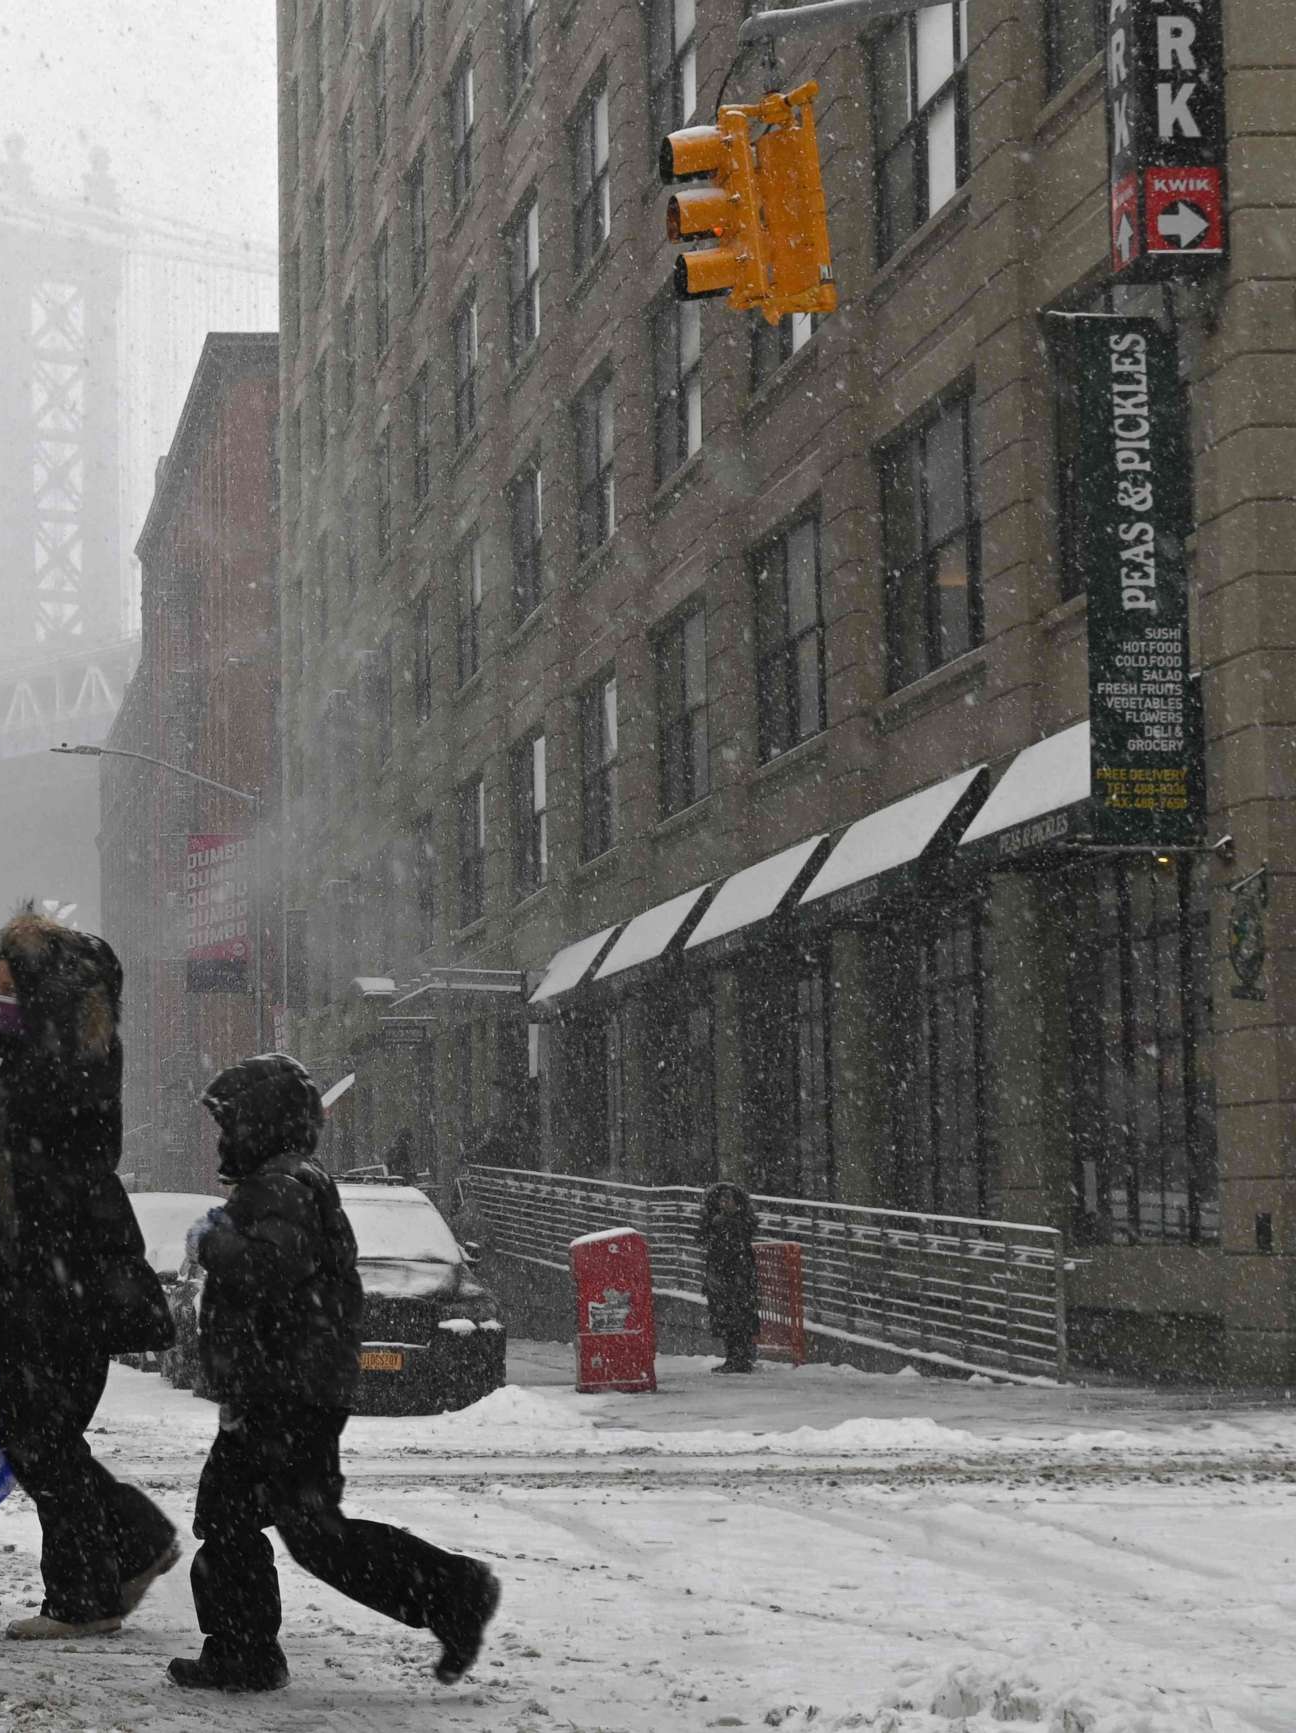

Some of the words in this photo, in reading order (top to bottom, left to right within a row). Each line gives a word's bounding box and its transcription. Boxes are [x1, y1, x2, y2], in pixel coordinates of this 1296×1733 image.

[1151, 0, 1202, 138] RK
[1154, 178, 1211, 192] KWIK
[1109, 333, 1152, 473] PICKLES
[1117, 481, 1153, 512] &
[1118, 521, 1157, 612] PEAS
[1145, 628, 1181, 640] SUSHI
[1122, 641, 1146, 653] HOT
[1148, 641, 1182, 653] FOOD
[1115, 655, 1147, 668] COLD
[1150, 655, 1182, 668] FOOD
[1142, 669, 1182, 682] SALAD
[1097, 683, 1137, 695] FRESH
[1140, 683, 1183, 695] FRUITS
[1106, 697, 1183, 709] VEGETABLES
[1125, 711, 1183, 723] FLOWERS
[1144, 725, 1171, 738] DELI
[1174, 725, 1183, 737] &
[1127, 739, 1184, 751] GROCERY
[1096, 768, 1127, 780] FREE
[1130, 767, 1188, 781] DELIVERY
[187, 840, 247, 870] DUMBO
